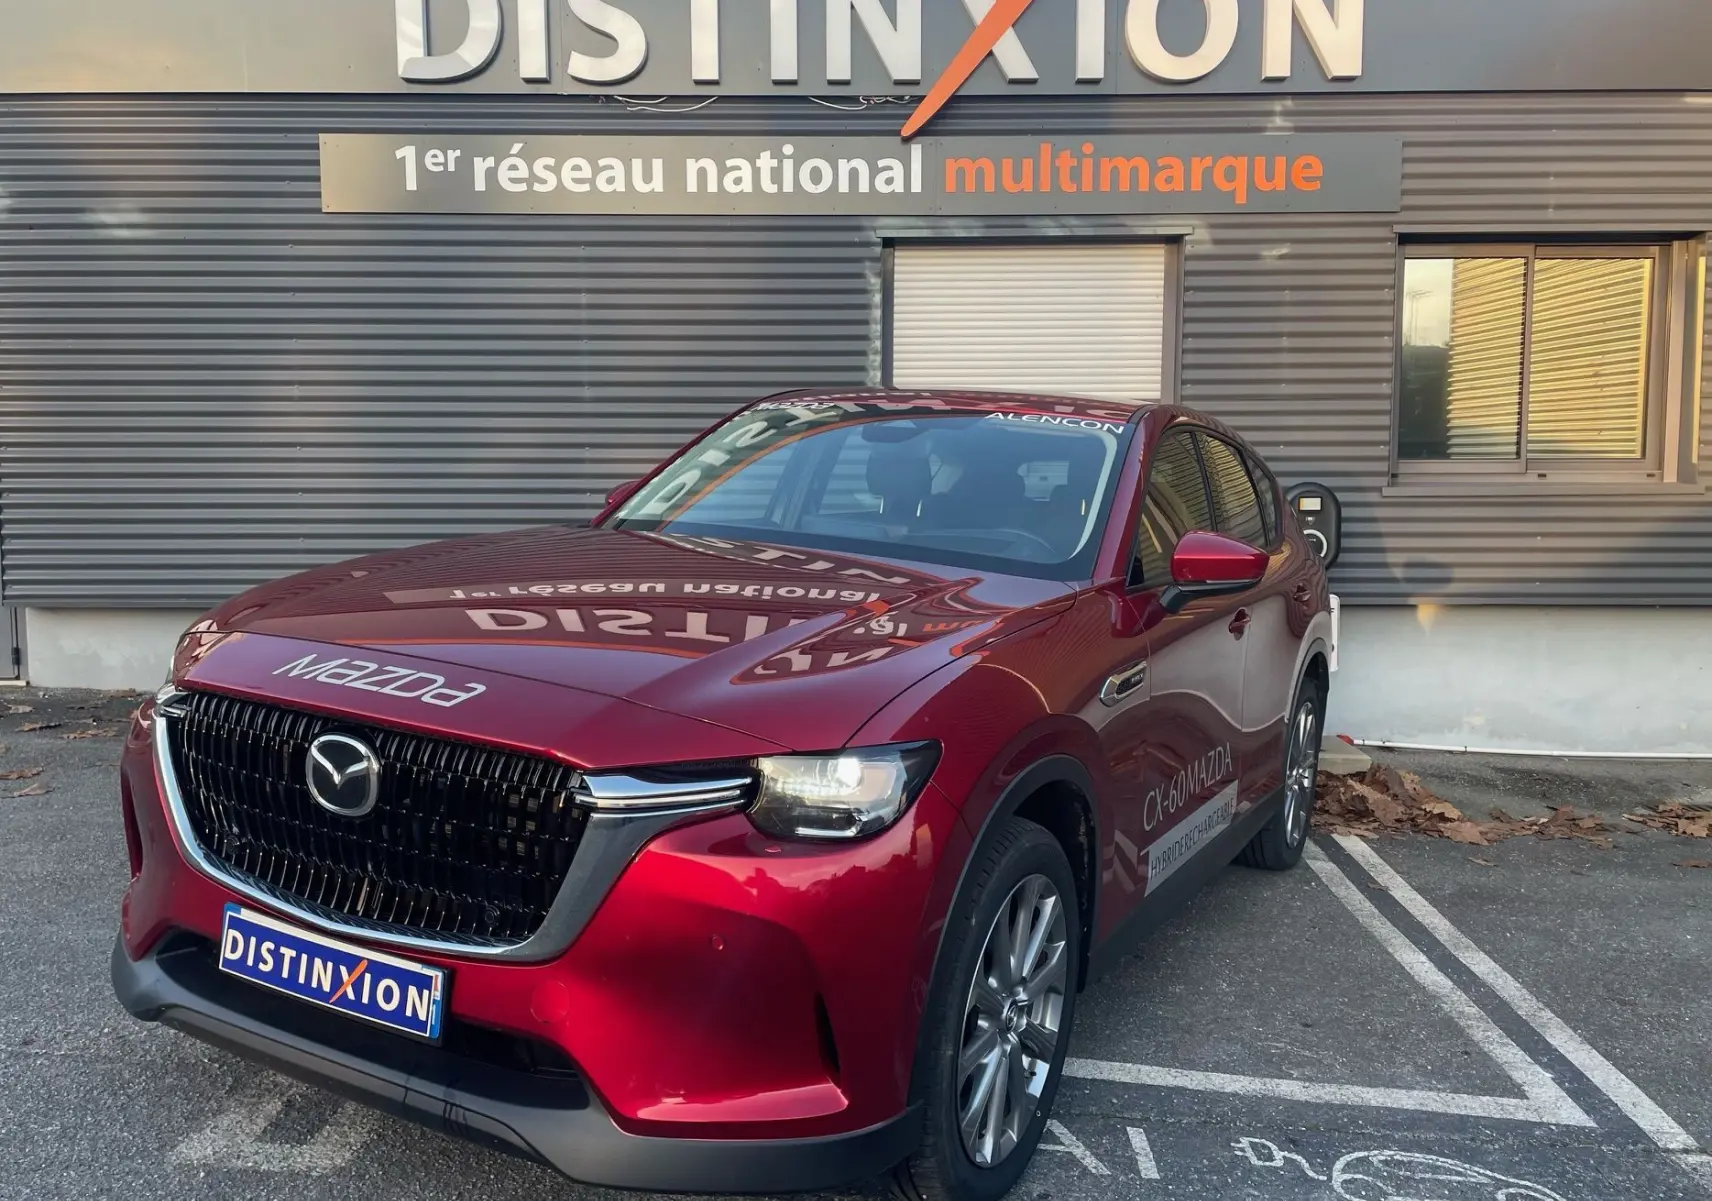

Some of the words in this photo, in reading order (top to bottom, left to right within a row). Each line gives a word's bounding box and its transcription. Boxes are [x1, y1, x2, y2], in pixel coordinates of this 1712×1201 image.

[395, 145, 461, 191] 1er
[473, 143, 664, 193] réseau
[686, 143, 922, 194] national
[945, 142, 1324, 205] multimarque
[224, 928, 430, 1022] DISTINXION
